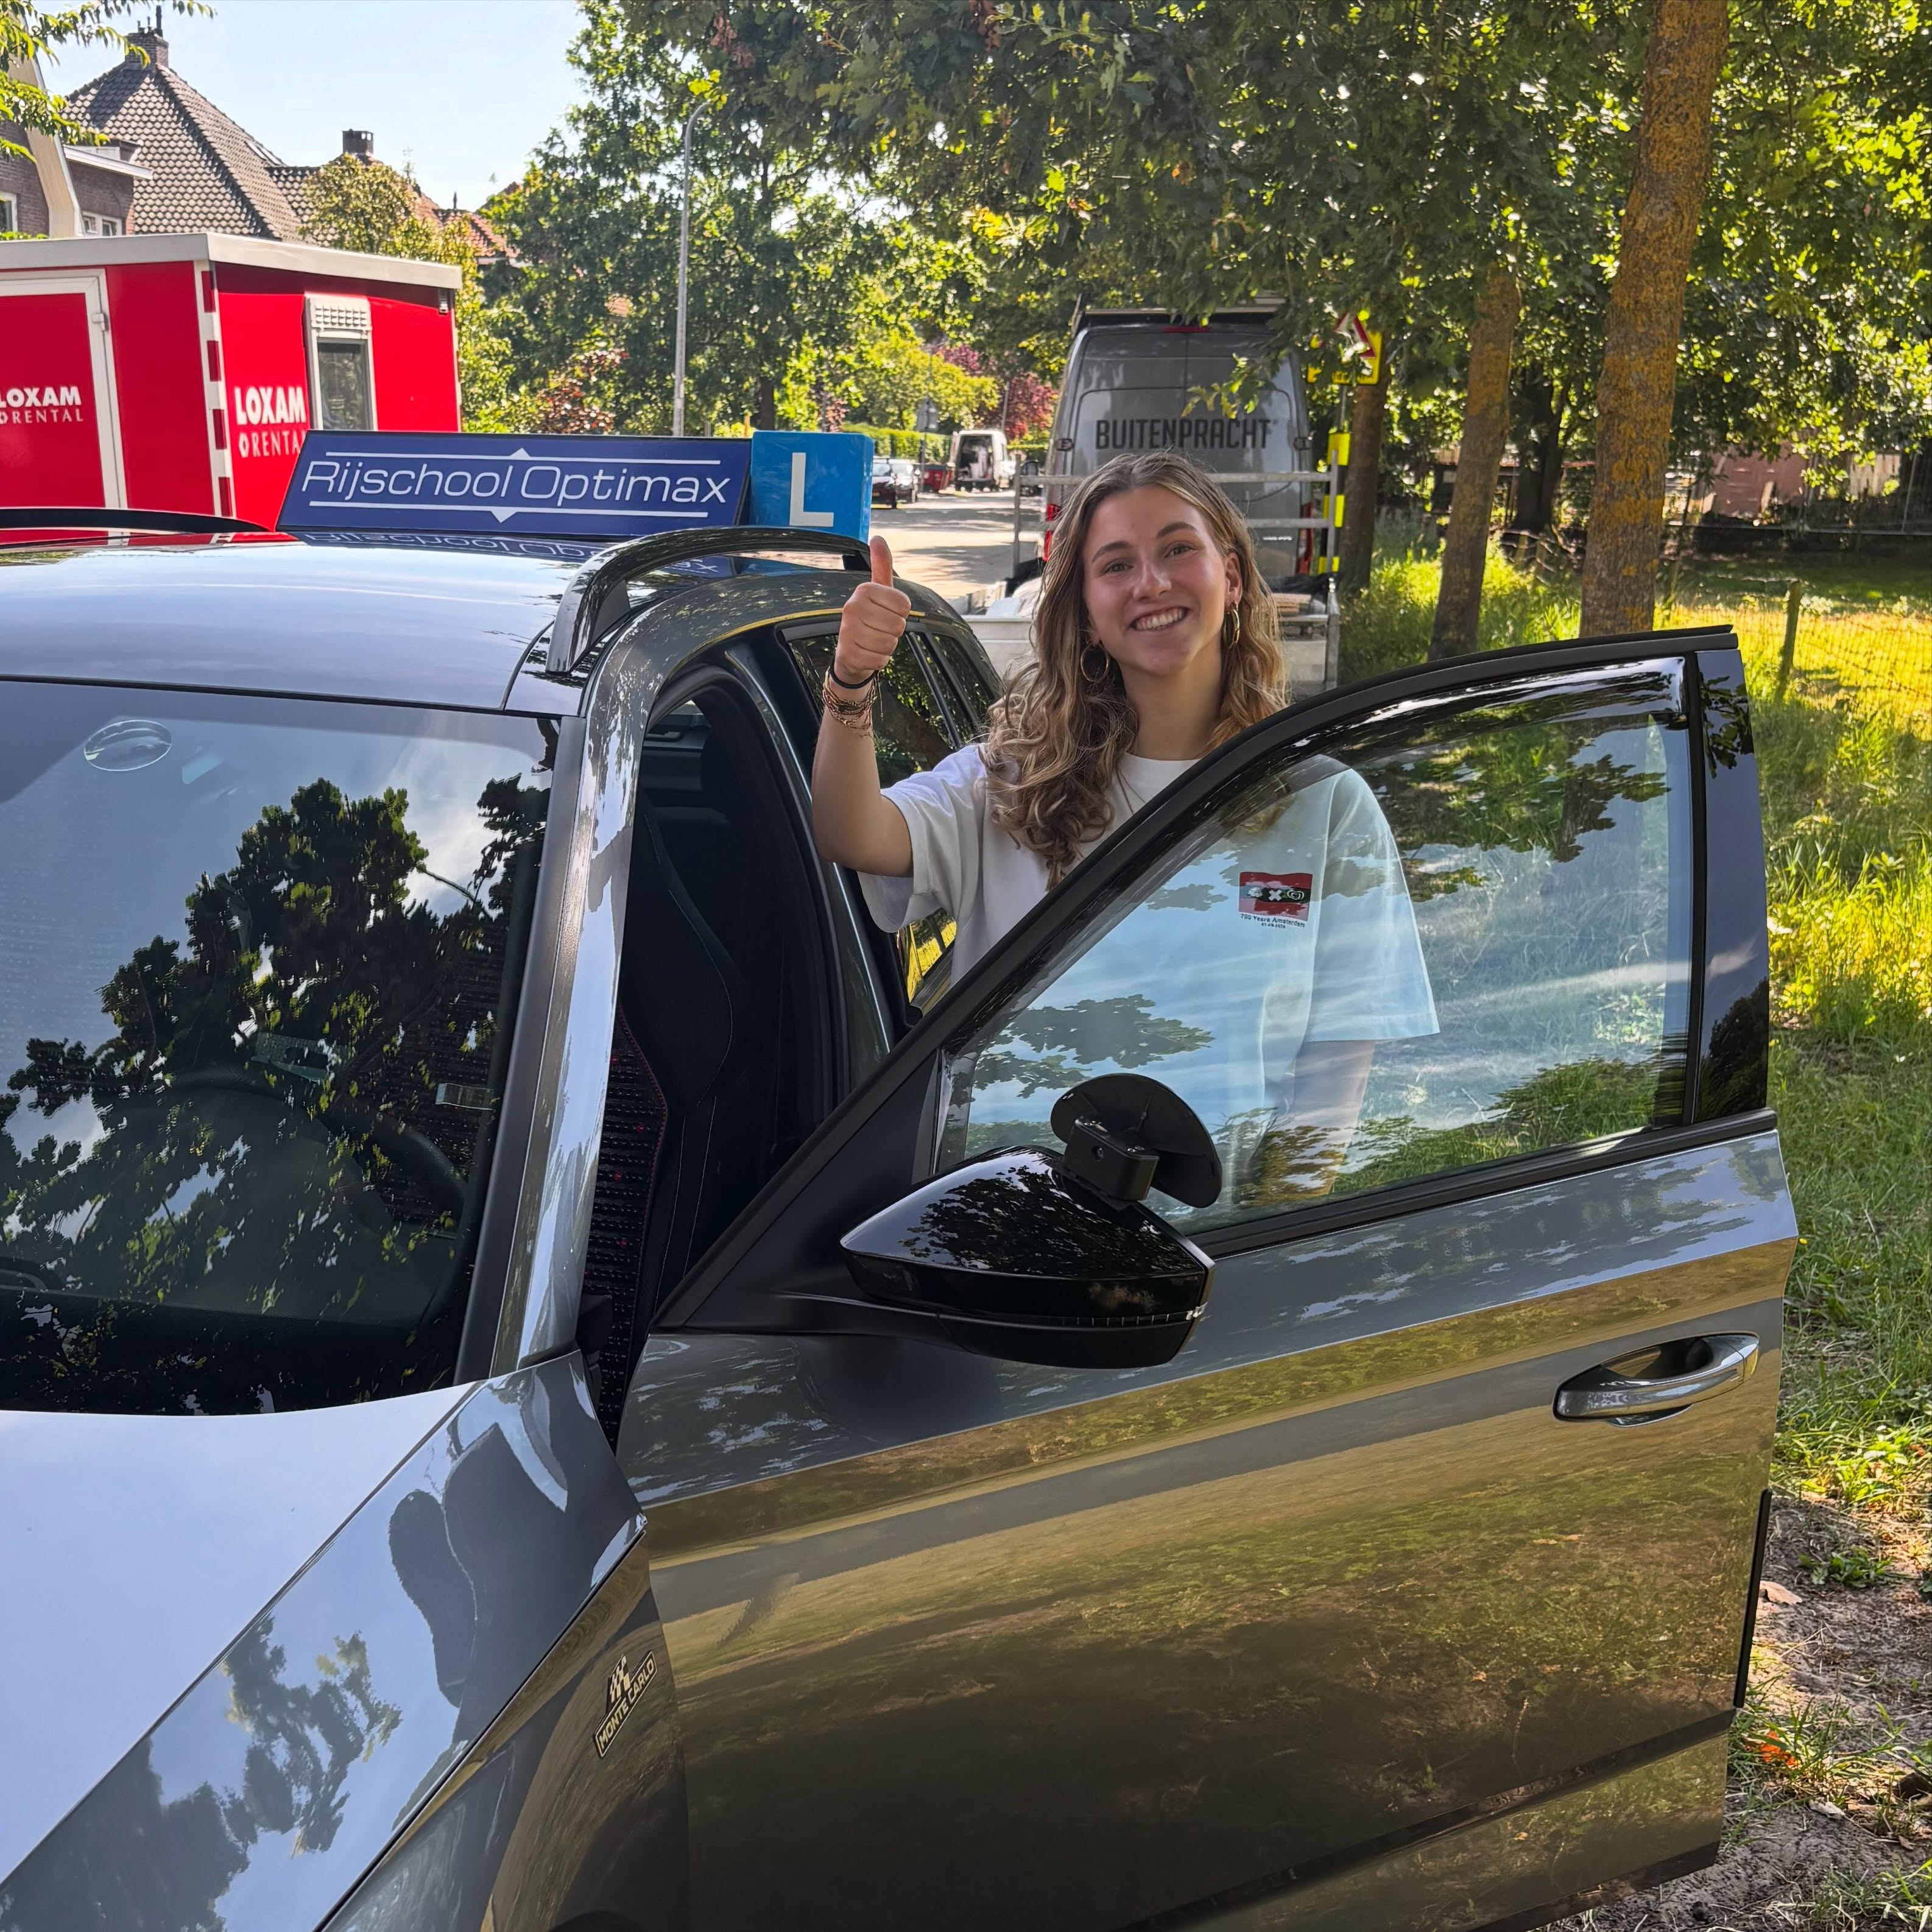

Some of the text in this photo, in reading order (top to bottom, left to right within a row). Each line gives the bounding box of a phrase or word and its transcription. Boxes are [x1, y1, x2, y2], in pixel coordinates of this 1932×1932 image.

[12, 408, 83, 424] RENTAL
[234, 386, 306, 425] LOXAM
[1095, 418, 1271, 450] BUITENPRACHT
[301, 461, 731, 507] Rijschool Optimax
[788, 452, 834, 527] L
[599, 1659, 654, 1749] MONTE CARLO
